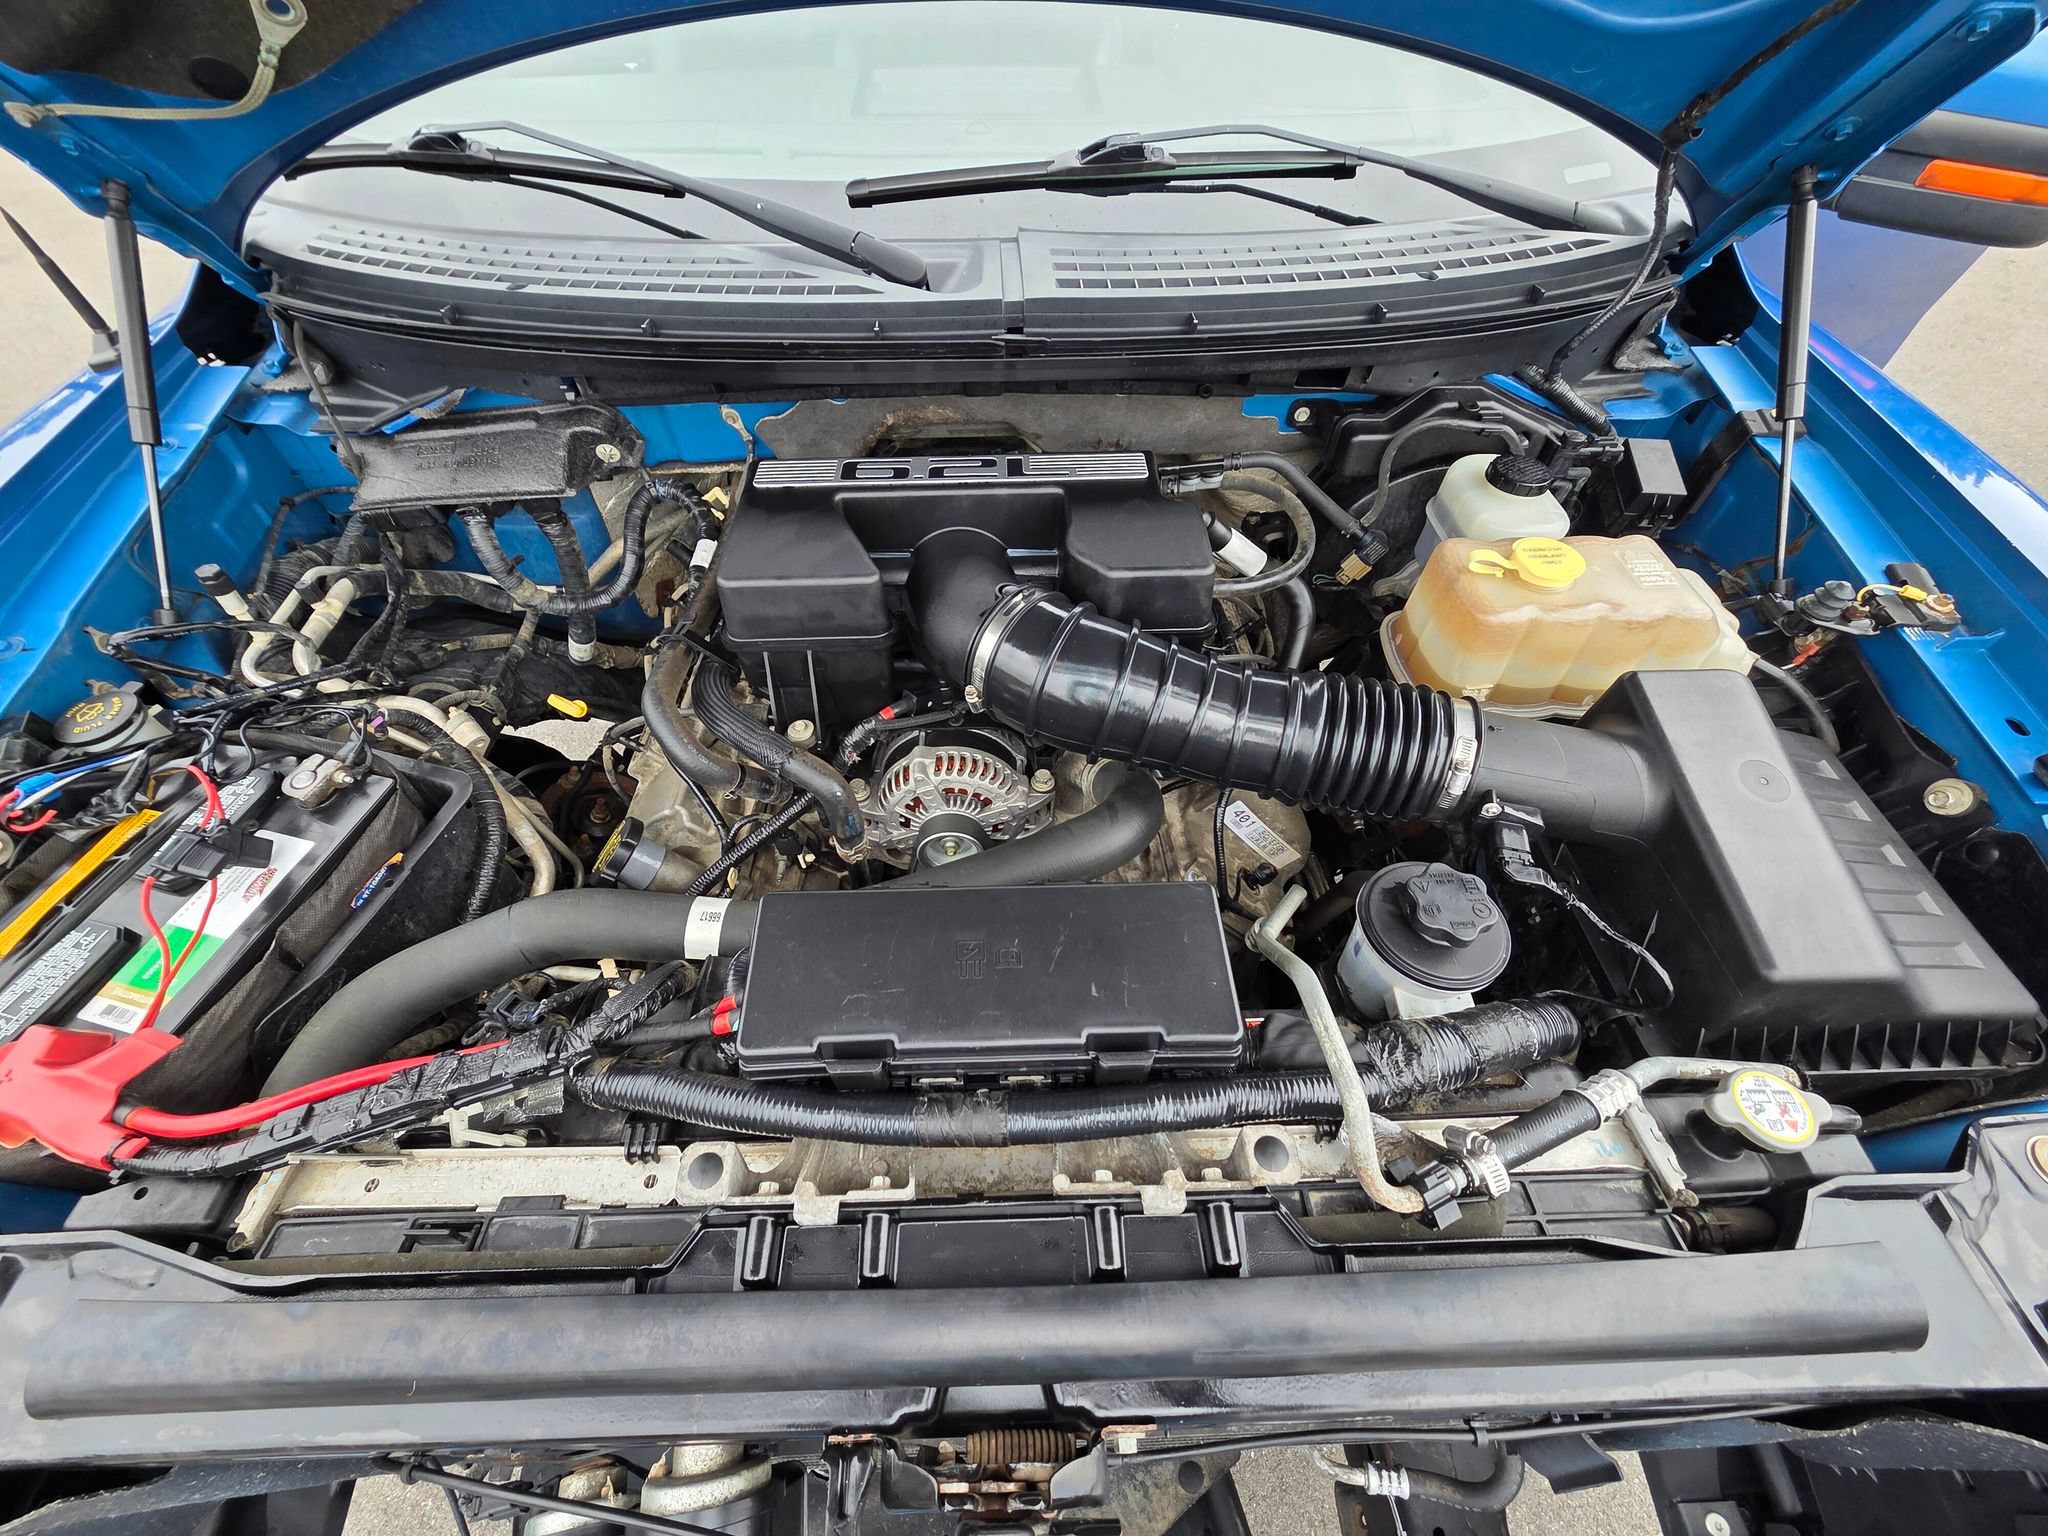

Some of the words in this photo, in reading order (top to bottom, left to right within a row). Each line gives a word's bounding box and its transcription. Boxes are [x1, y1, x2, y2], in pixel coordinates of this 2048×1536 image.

[840, 456, 1071, 481] 6.2L
[73, 720, 104, 735] FLUID
[1233, 810, 1257, 828] 401
[700, 911, 721, 922] 66617
